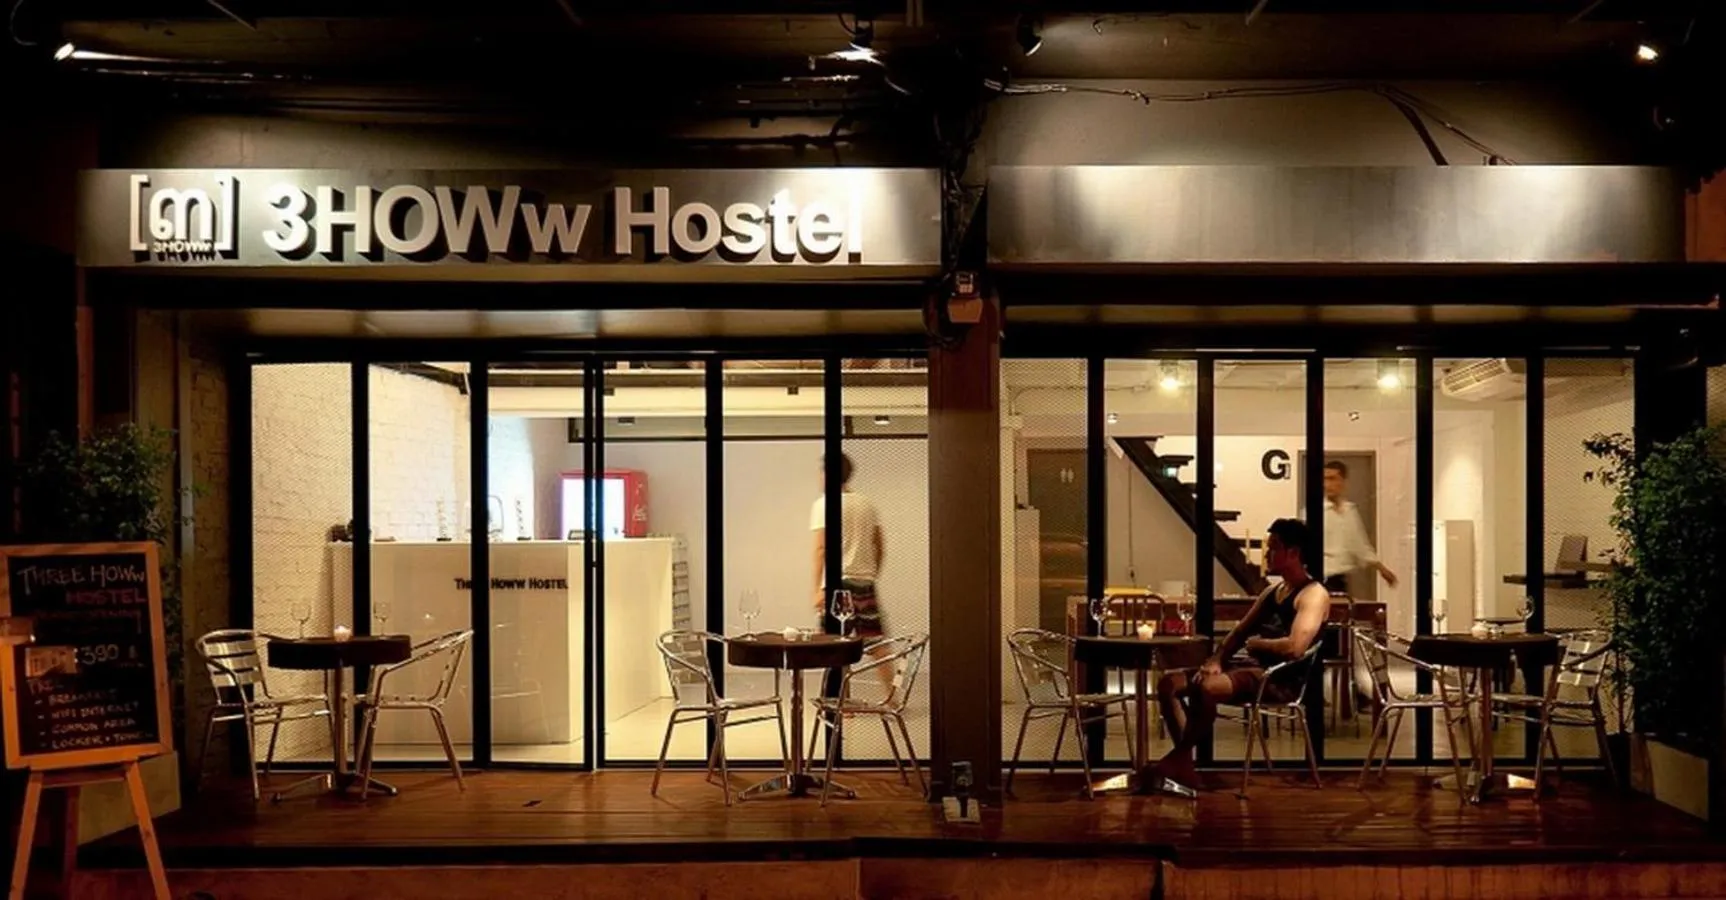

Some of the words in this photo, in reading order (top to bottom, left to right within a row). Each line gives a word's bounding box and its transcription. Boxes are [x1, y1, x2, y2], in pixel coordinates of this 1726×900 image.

[614, 184, 862, 254] Hostel
[16, 564, 87, 597] THREE
[65, 587, 147, 606] HOSTEL
